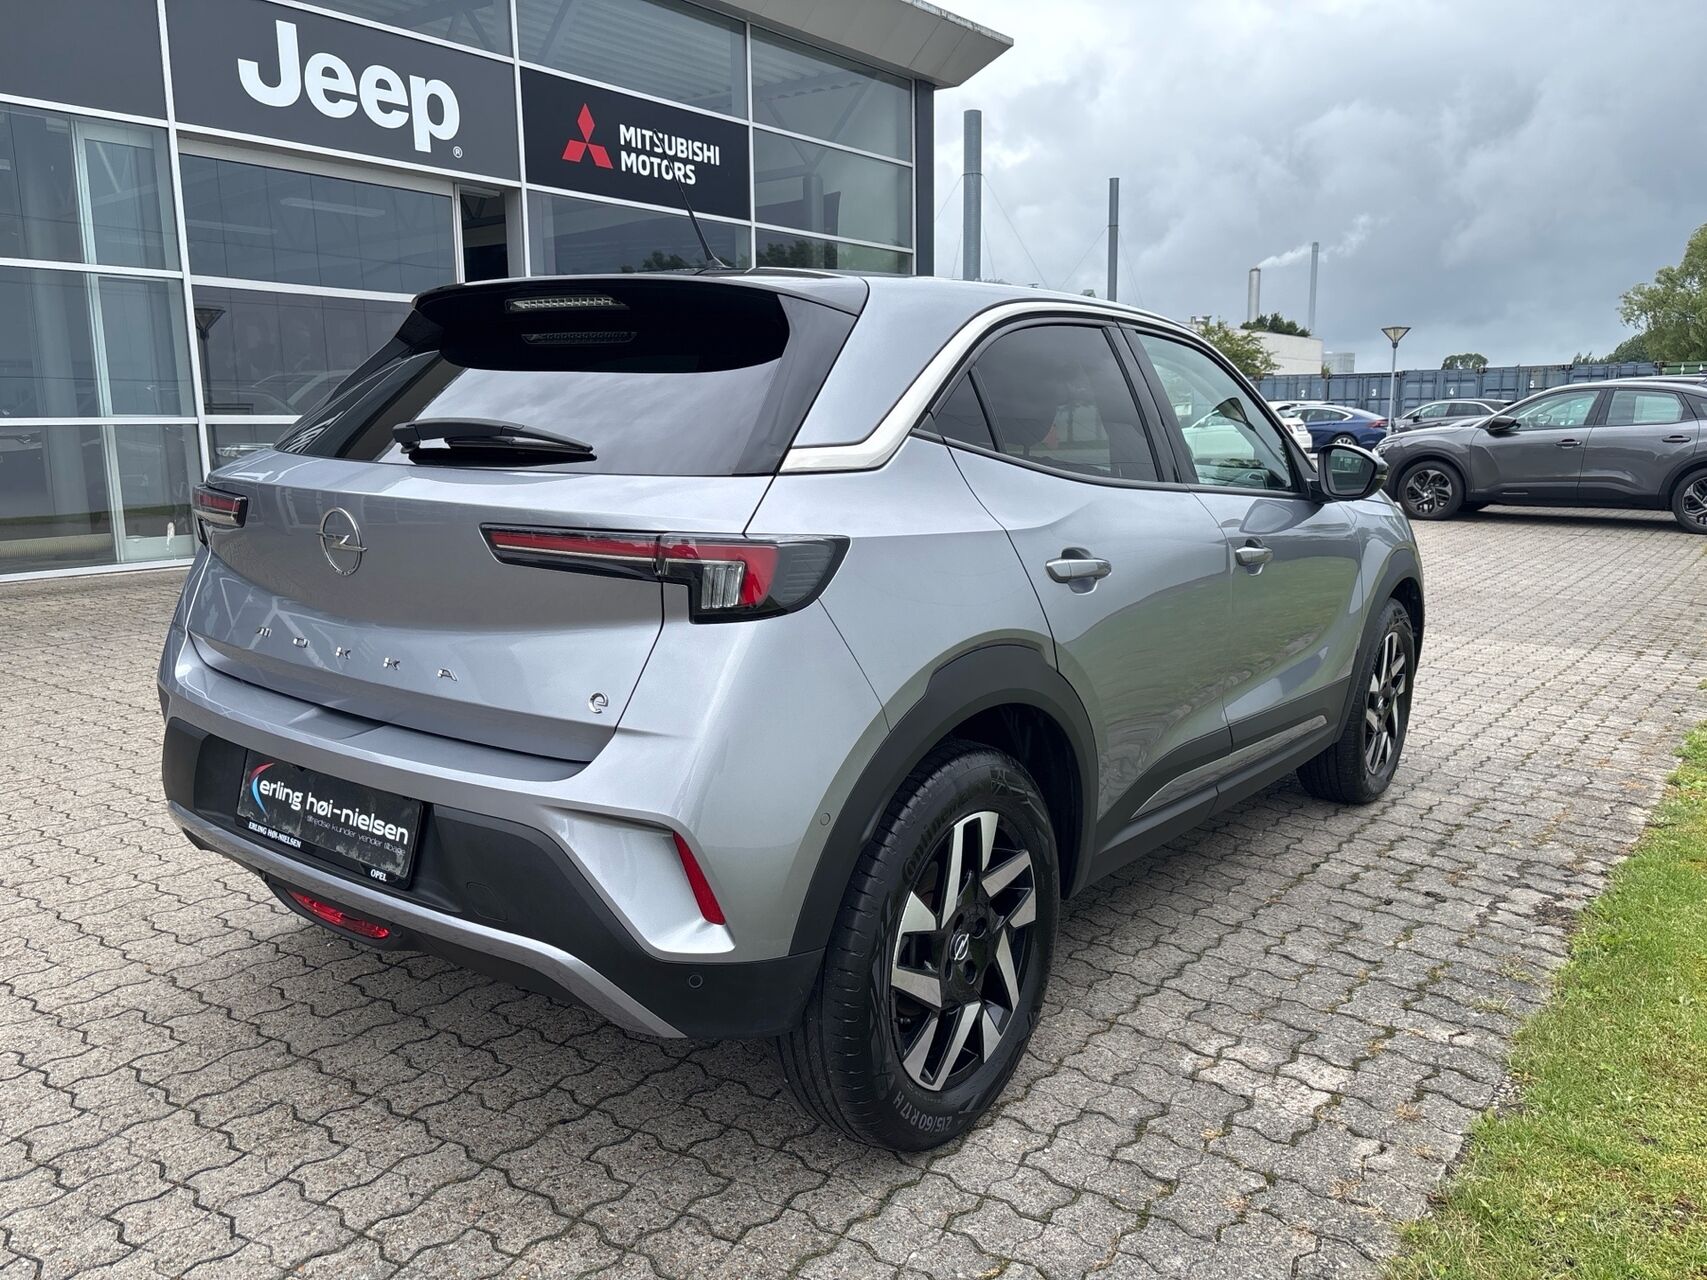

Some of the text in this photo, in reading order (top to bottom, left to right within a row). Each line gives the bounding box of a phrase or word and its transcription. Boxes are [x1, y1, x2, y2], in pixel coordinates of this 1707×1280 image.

[237, 19, 460, 153] Jeep
[619, 123, 720, 166] MITSUBISHI
[620, 150, 696, 185] MOTORS
[1370, 388, 1377, 397] 3
[1448, 387, 1455, 396] 4
[1529, 379, 1536, 389] 5
[259, 779, 409, 845] erling høi-nielsen
[902, 783, 982, 885] Continenta
[370, 869, 388, 882] OPEL
[892, 1090, 905, 1109] H
[899, 1101, 912, 1120] 17
[910, 1107, 920, 1126] R
[918, 1113, 953, 1133] 215/60
